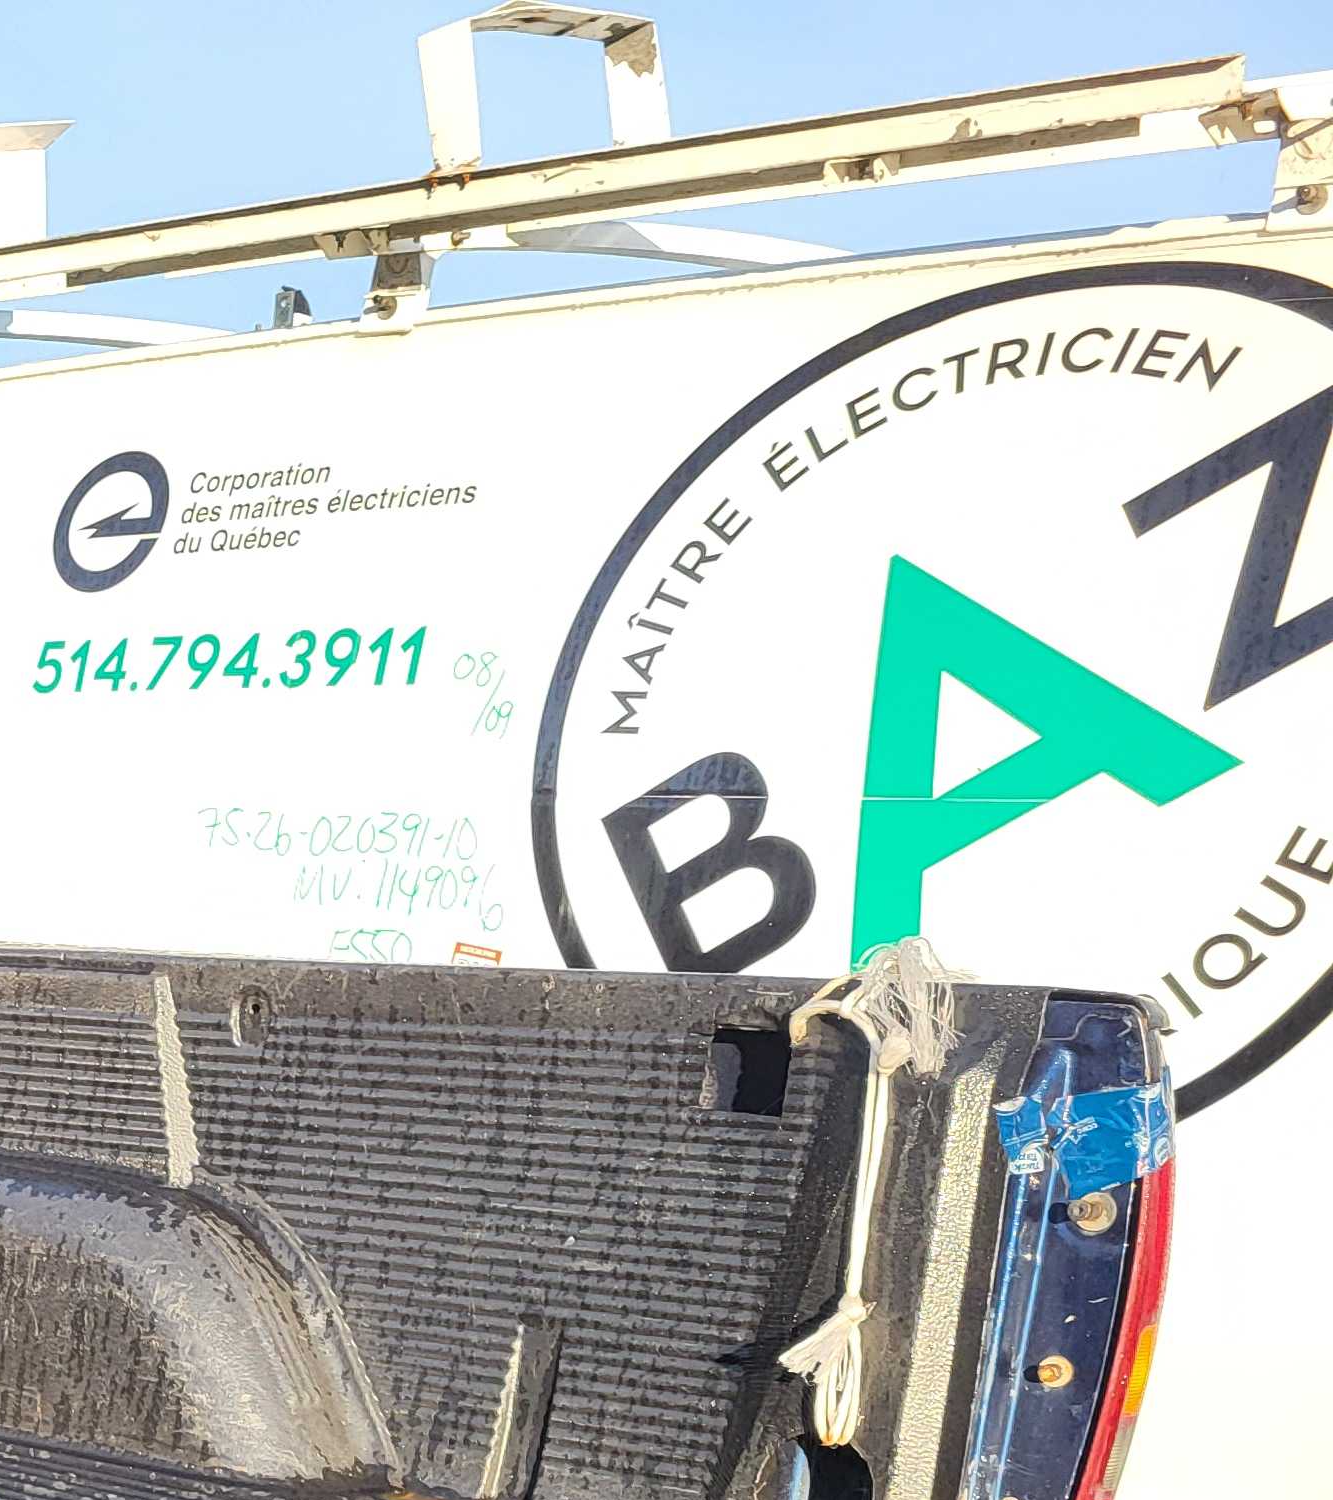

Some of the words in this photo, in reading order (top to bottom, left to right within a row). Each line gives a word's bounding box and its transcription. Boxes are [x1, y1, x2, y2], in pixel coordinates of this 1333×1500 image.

[180, 502, 221, 524] des
[229, 496, 318, 522] maîtres
[327, 482, 477, 514] électriciens
[190, 463, 331, 497] Corporation
[173, 531, 201, 555] du
[210, 526, 301, 553] Québec
[600, 497, 753, 735] MAÎTRE
[763, 327, 1243, 491] ÉLECTRICIEN
[32, 626, 428, 693] 514.794.3911
[1161, 825, 1333, 1019] IQUE
